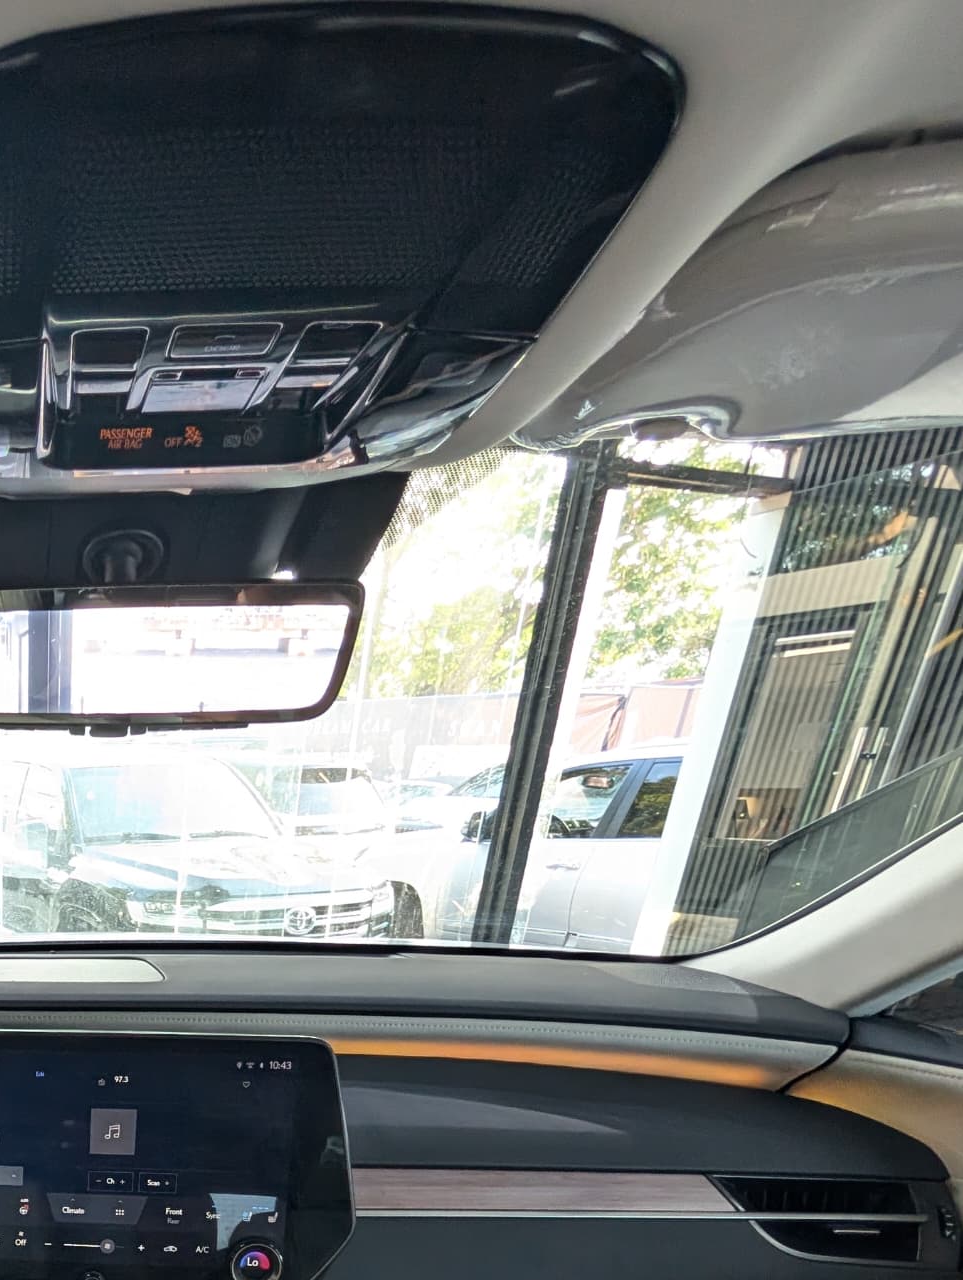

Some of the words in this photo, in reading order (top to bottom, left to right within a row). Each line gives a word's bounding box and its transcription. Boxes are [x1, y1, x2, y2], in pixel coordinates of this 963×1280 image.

[100, 427, 153, 440] PASSENGER
[108, 438, 123, 449] AIR
[124, 438, 143, 449] BAG
[164, 437, 182, 448] OFF
[269, 1060, 292, 1070] 10:43
[114, 1075, 129, 1083] 97.3
[106, 1177, 115, 1185] Ch
[147, 1179, 161, 1187] Scan
[62, 1206, 85, 1215] Climate
[165, 1207, 183, 1216] Front
[205, 1211, 221, 1220] Sync
[14, 1237, 27, 1247] Off
[195, 1245, 210, 1254] A/C
[247, 1256, 259, 1267] Lo
